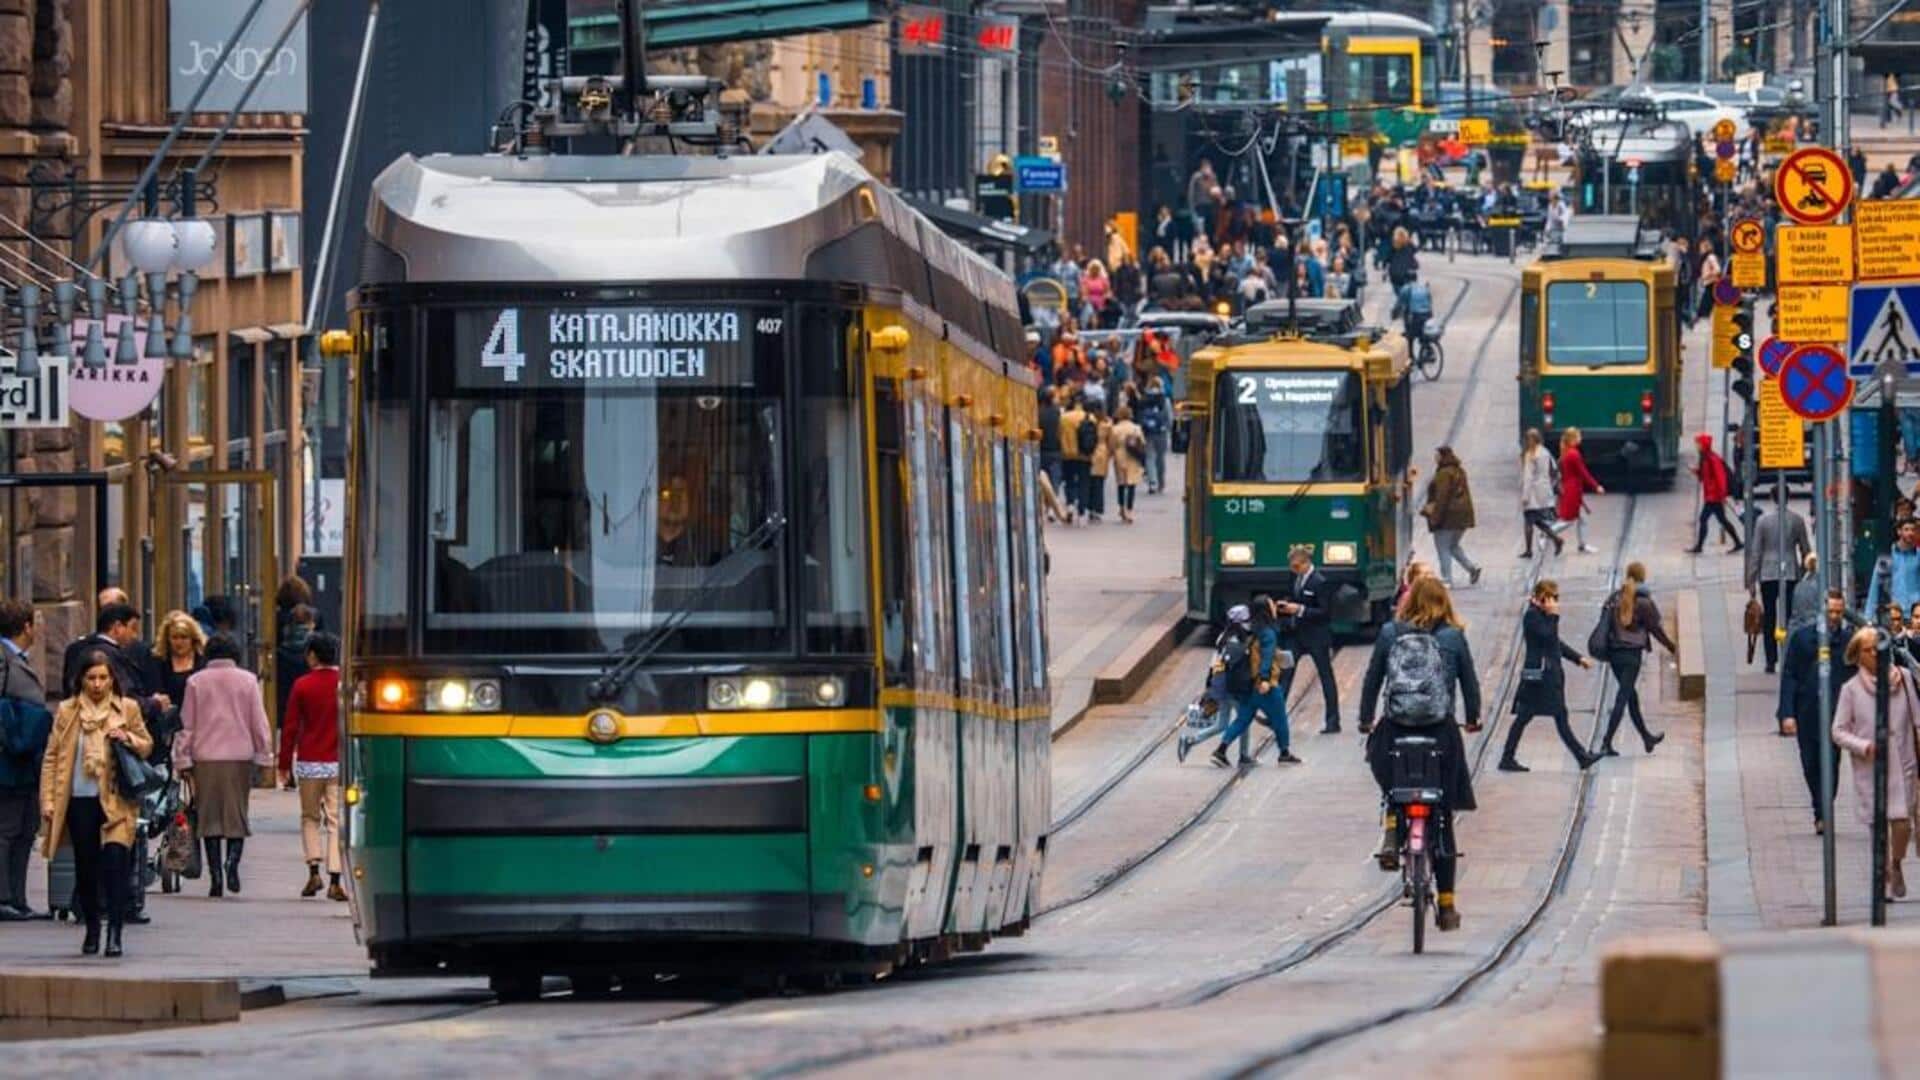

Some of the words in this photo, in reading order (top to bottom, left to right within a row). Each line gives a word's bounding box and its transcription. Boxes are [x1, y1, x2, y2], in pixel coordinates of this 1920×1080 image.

[756, 319, 783, 333] 407
[480, 308, 526, 382] 4
[550, 313, 739, 343] KATAJANOKKA
[74, 368, 149, 382] ARIKKA
[550, 348, 705, 378] SKATUDDEN
[1238, 377, 1257, 404] 2
